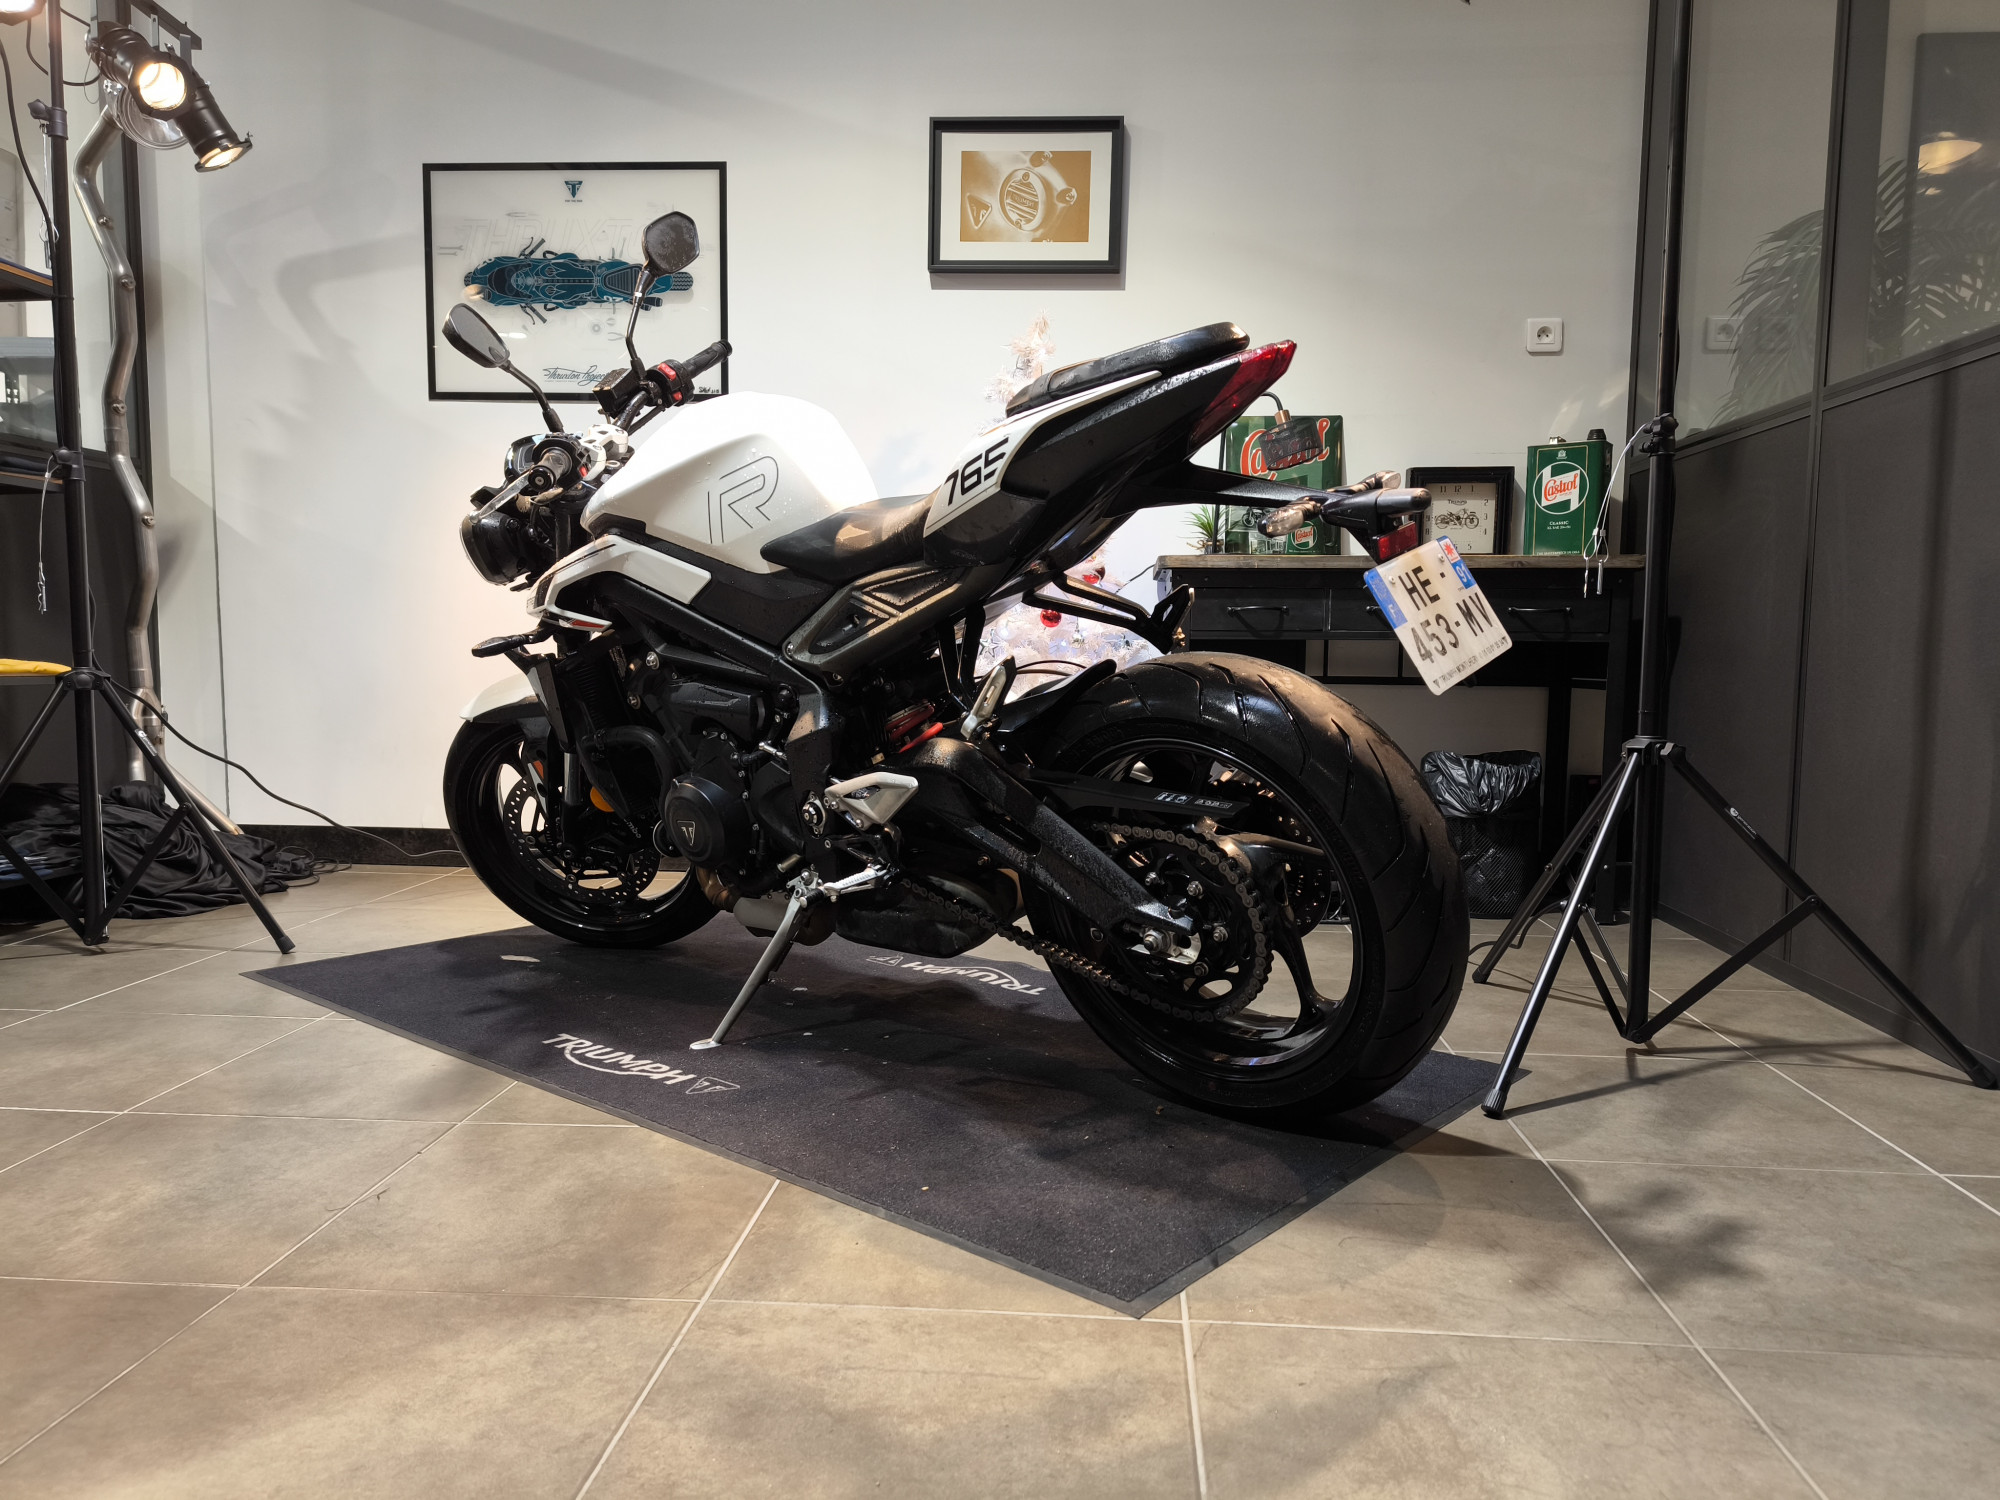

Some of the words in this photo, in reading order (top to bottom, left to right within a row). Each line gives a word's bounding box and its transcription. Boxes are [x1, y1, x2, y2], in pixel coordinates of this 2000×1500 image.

[946, 437, 1008, 506] 765
[1544, 473, 1578, 502] Castrol
[1295, 528, 1314, 542] Castrol
[1455, 564, 1472, 583] 91
[901, 961, 1047, 996] TRIUMPH
[541, 1033, 697, 1085] TRIUMPH
